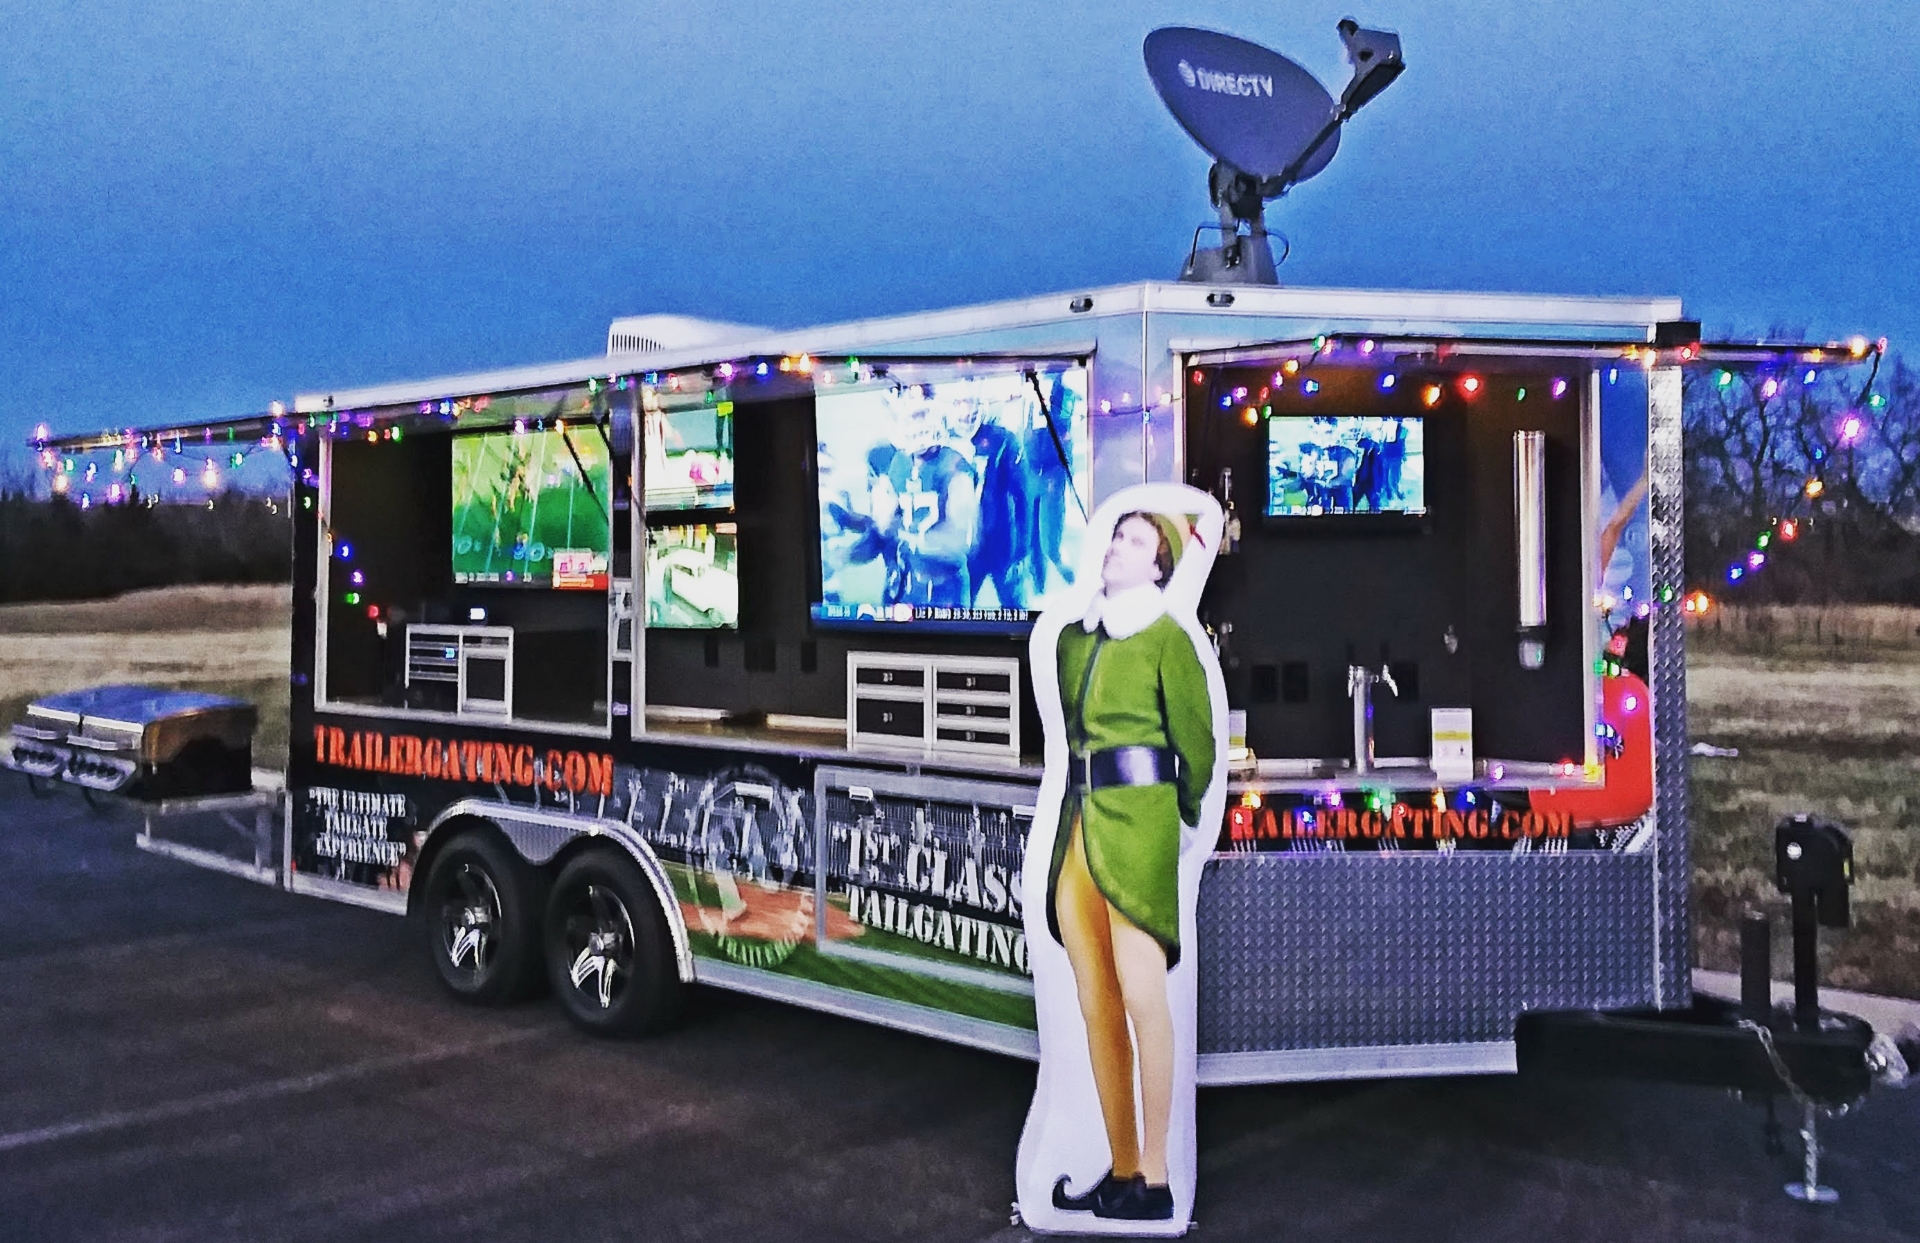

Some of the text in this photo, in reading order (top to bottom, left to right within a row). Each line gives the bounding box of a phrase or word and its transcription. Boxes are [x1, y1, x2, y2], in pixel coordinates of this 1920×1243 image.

[1197, 67, 1273, 98] DIRECTV
[313, 724, 614, 796] TRAILERGATING.COM
[1226, 806, 1572, 841] RAILERGATING.COM
[846, 882, 1033, 975] TAILGATING
